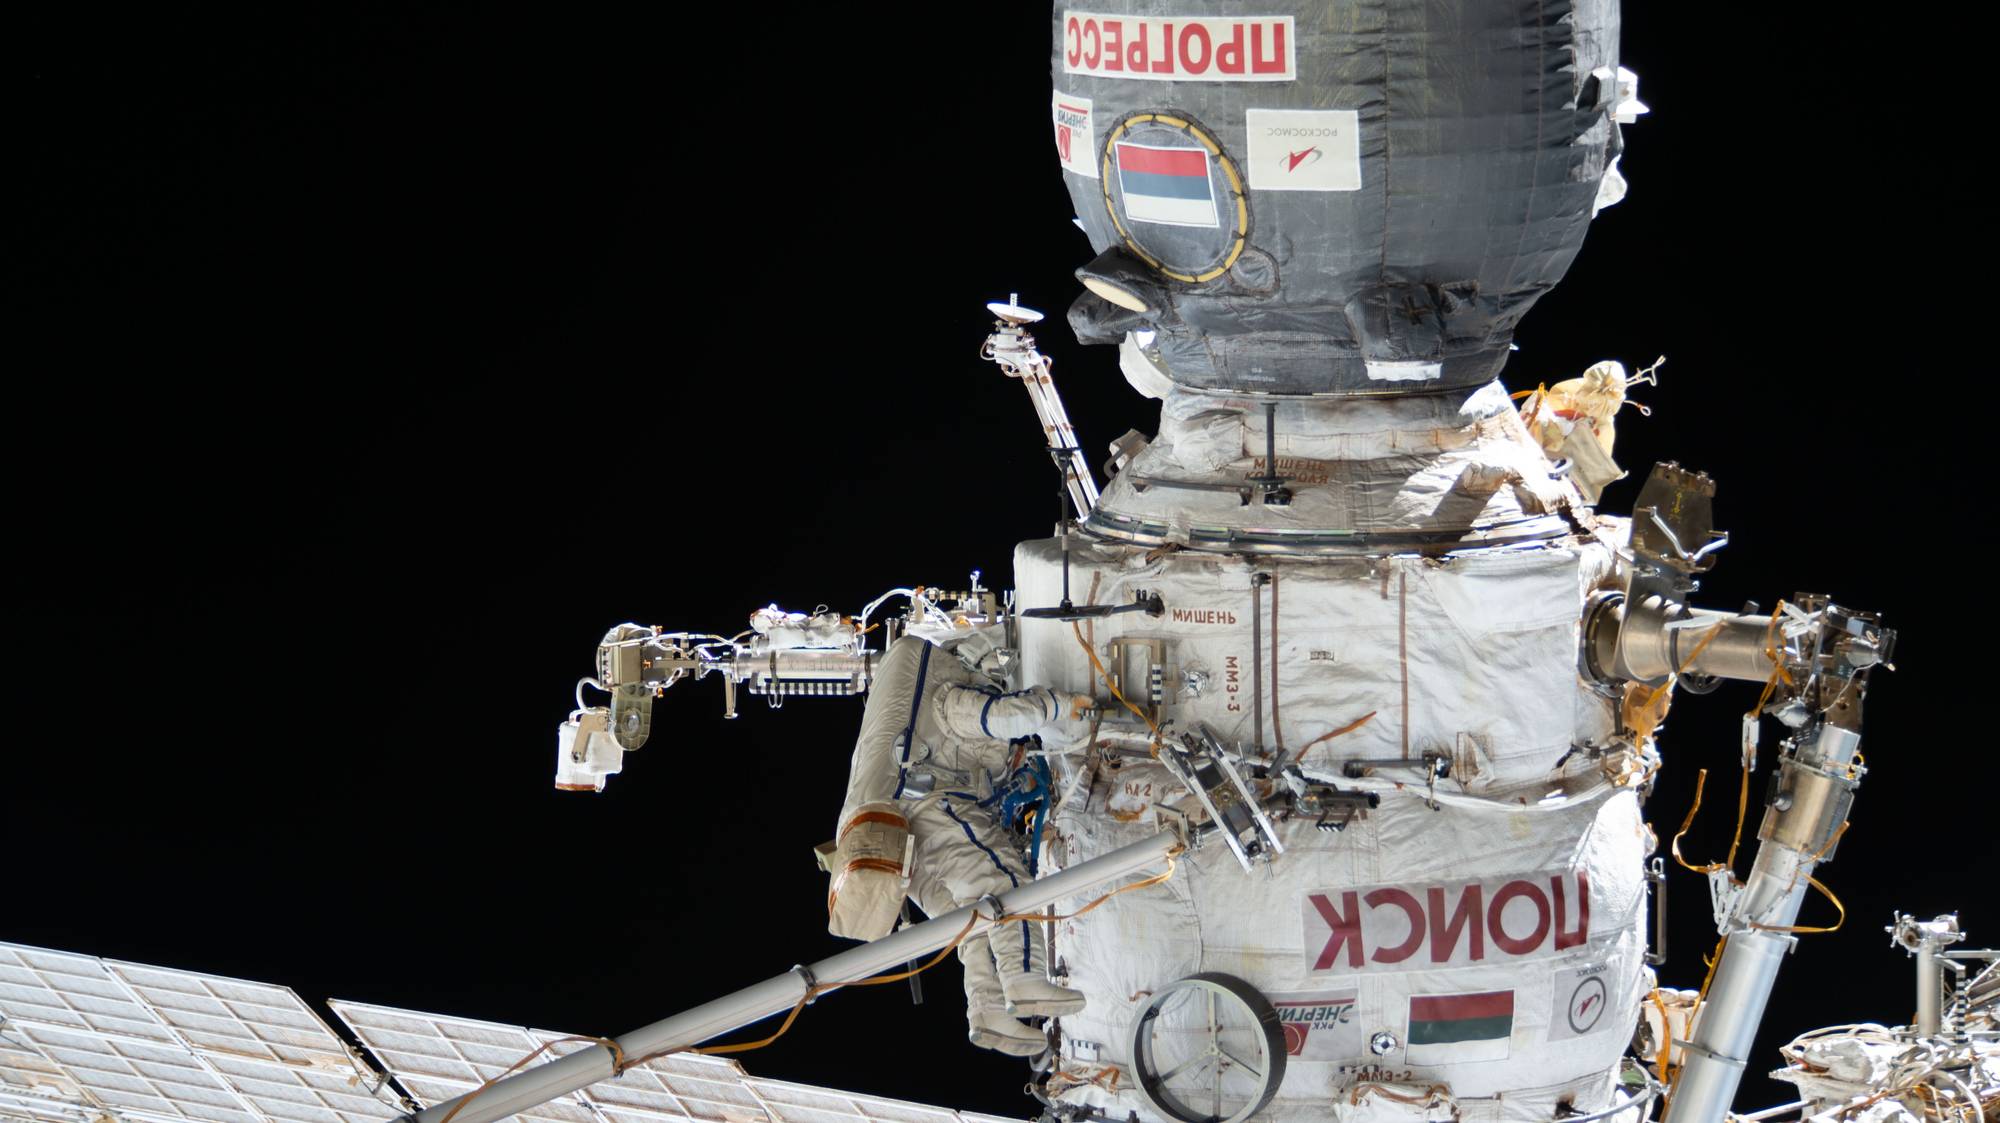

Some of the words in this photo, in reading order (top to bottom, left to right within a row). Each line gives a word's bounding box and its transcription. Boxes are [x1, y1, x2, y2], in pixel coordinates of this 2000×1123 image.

[1067, 17, 1286, 75] ПРОГРЕСС
[1266, 127, 1338, 137] РОСКОСМОС
[1172, 609, 1237, 624] МИШЕНЬ
[1307, 869, 1590, 971] ПОИСК
